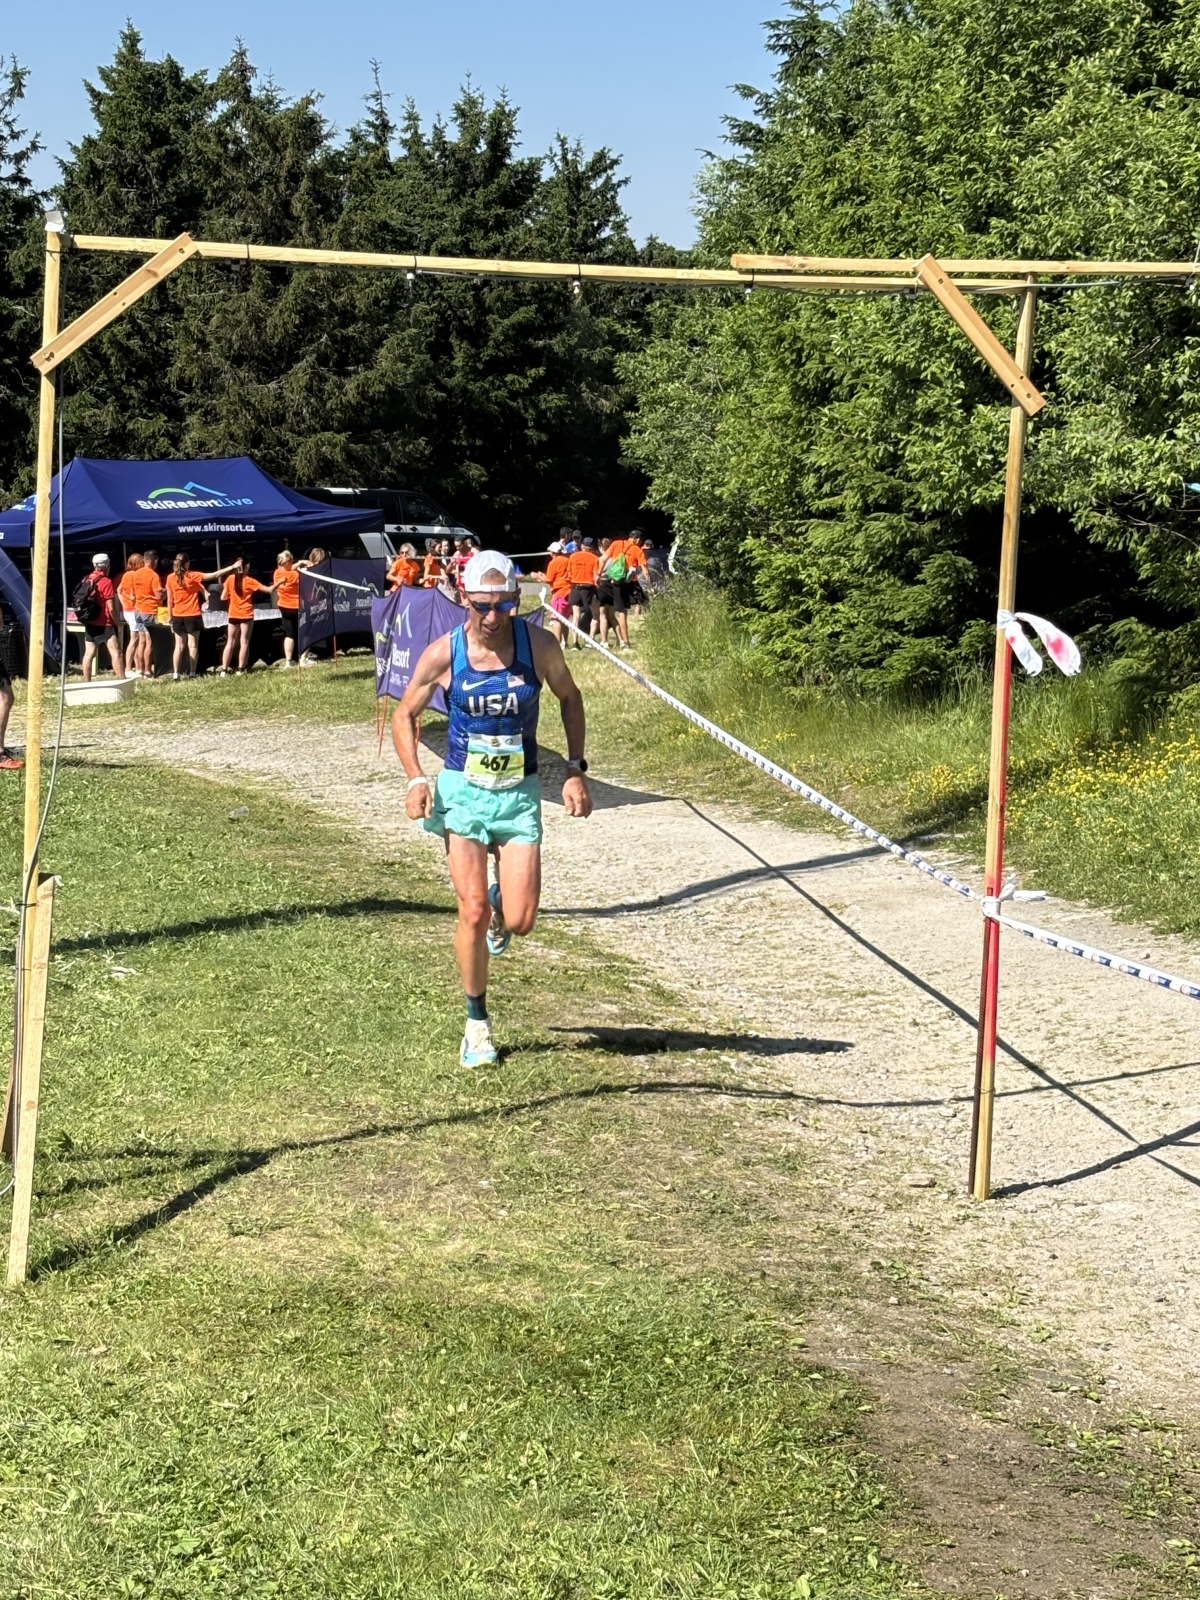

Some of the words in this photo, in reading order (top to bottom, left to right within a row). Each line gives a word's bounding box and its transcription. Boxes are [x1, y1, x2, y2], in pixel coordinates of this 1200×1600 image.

[178, 523, 256, 534] www.skiresort.cz
[468, 692, 519, 717] USA
[480, 753, 511, 772] 467
